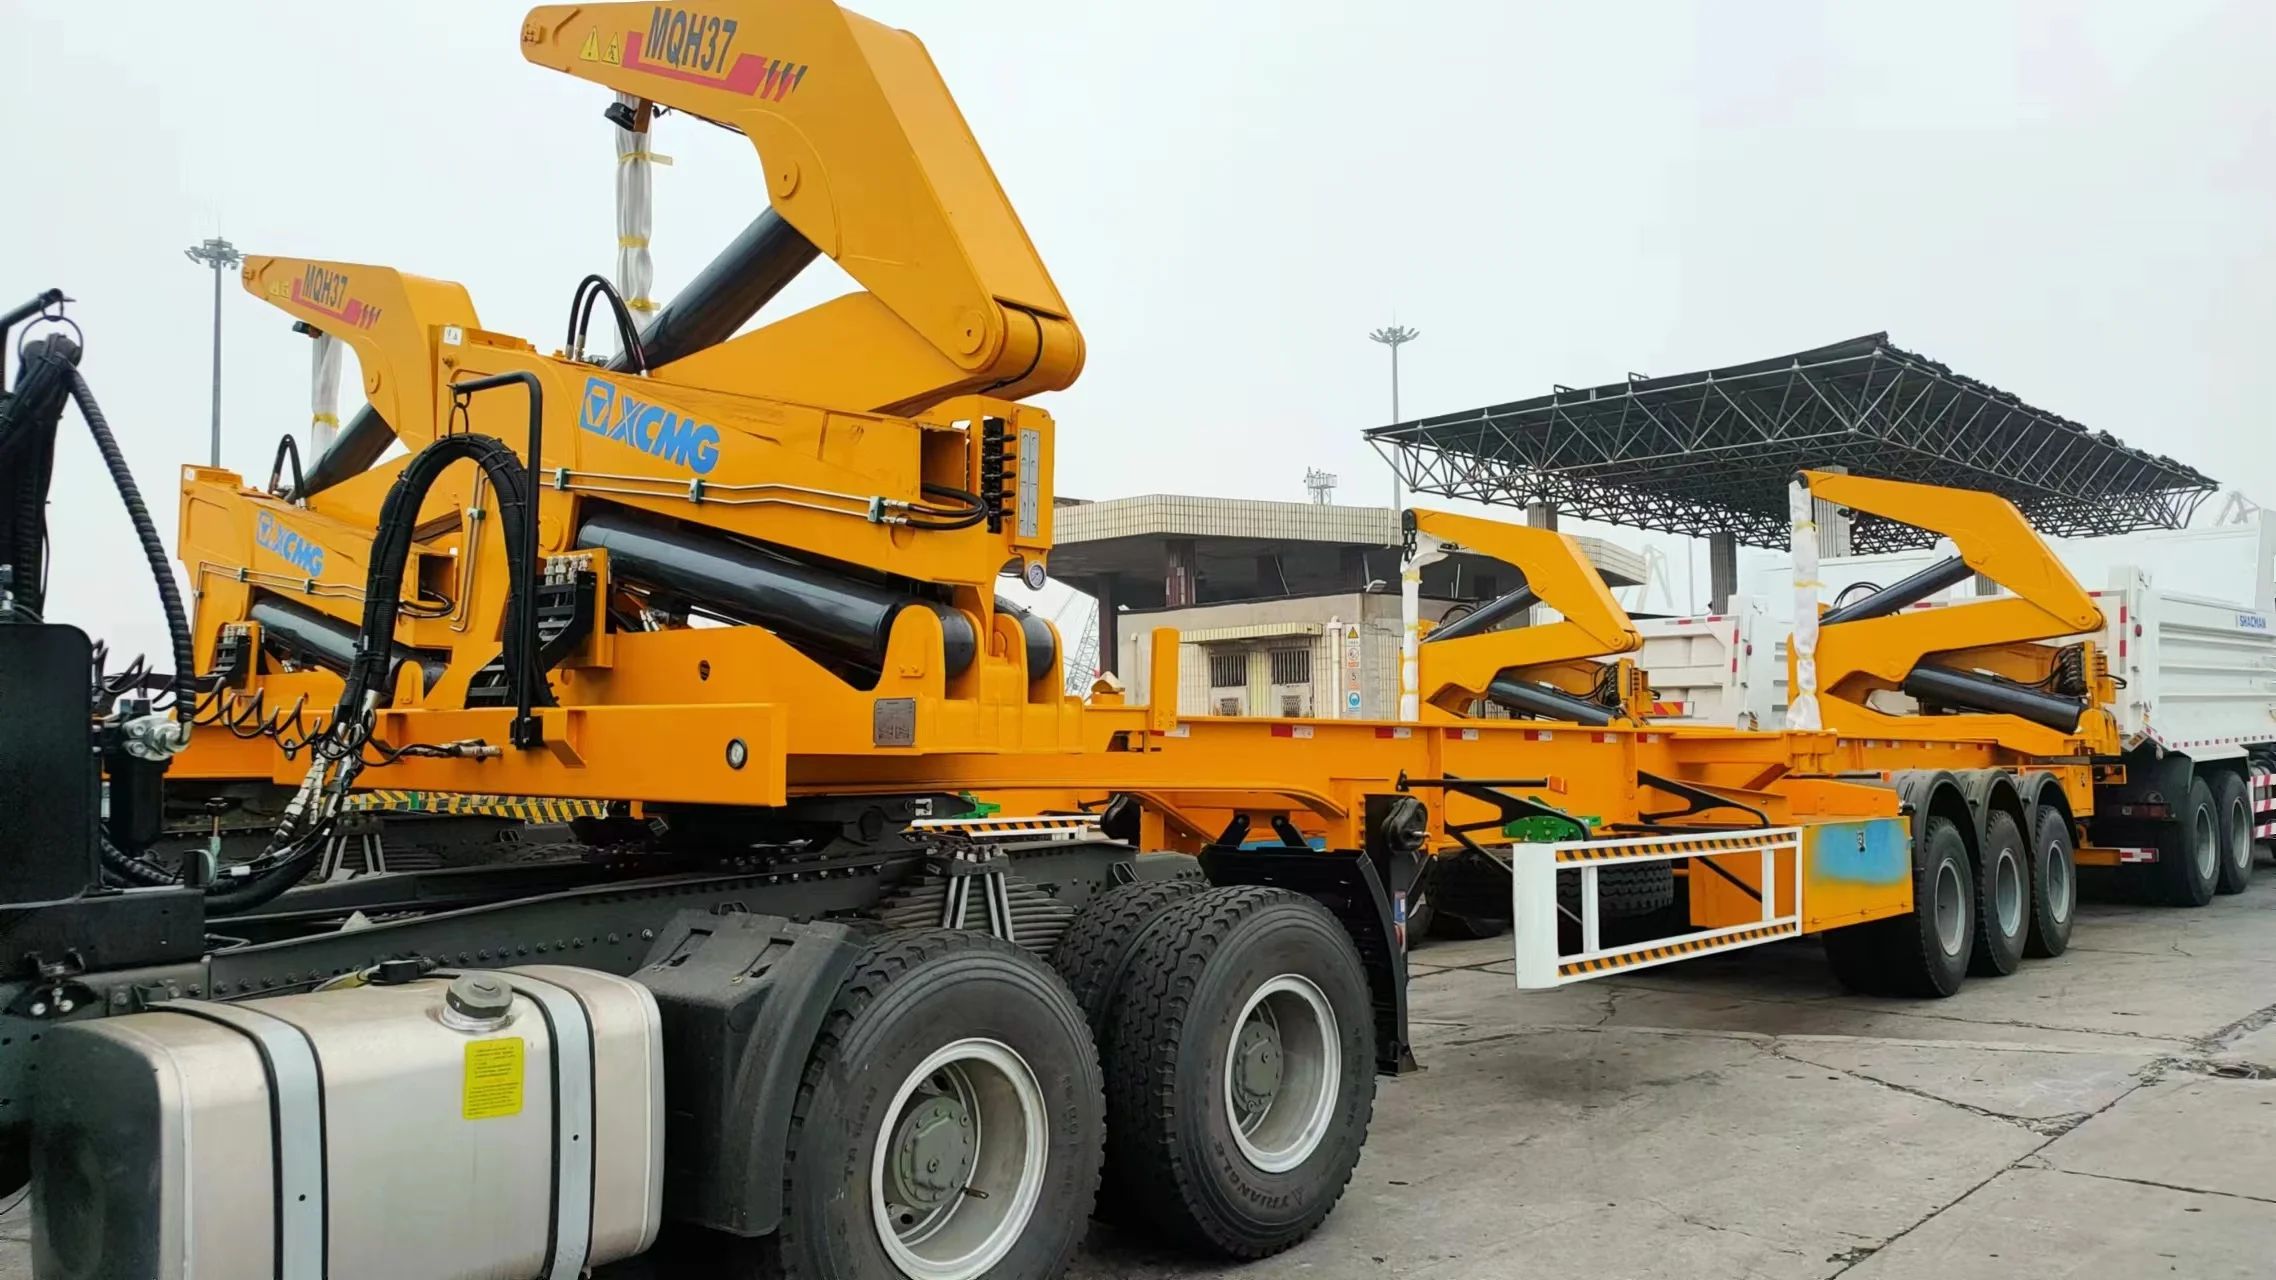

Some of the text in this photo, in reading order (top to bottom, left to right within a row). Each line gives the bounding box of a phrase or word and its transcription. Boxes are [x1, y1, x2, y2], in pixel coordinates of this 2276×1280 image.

[645, 6, 738, 74] MQH37
[301, 263, 349, 309] MQH37
[608, 394, 721, 475] XCMG
[271, 523, 324, 577] XCMG
[2239, 615, 2267, 629] SHACMAN
[1213, 1140, 1290, 1209] TRIANGLE
